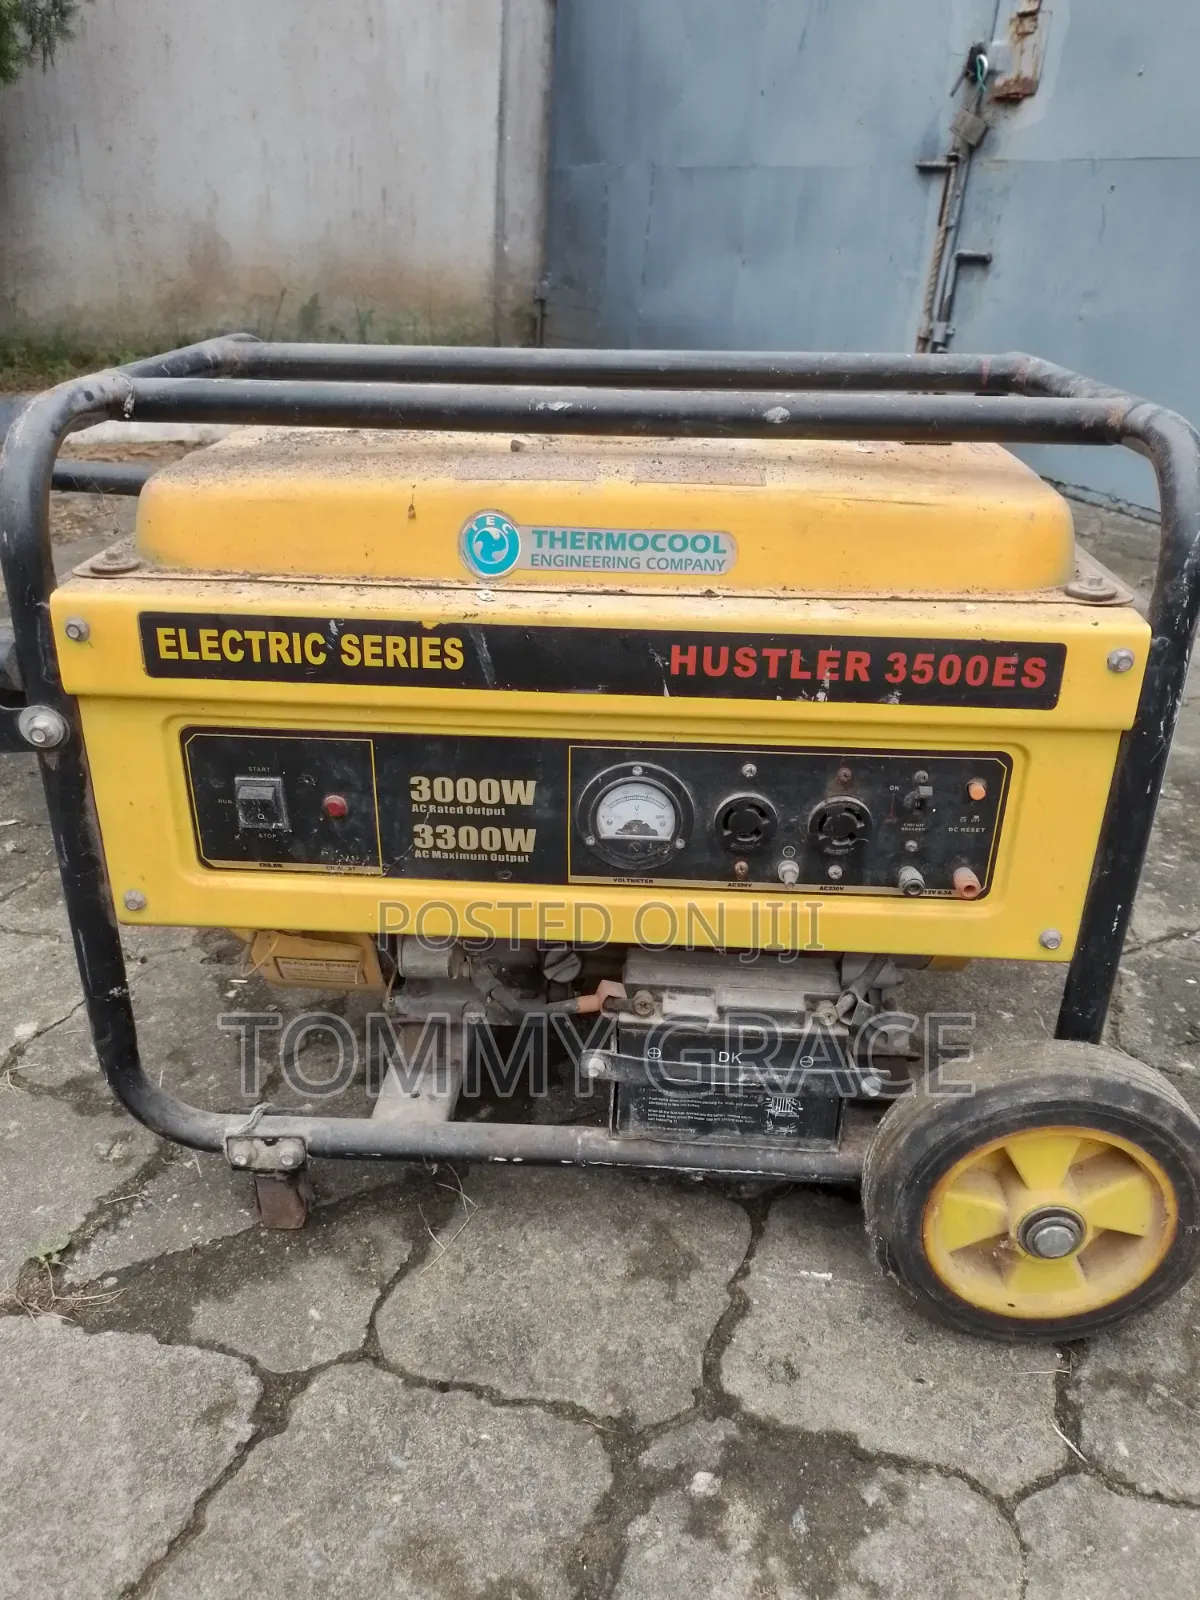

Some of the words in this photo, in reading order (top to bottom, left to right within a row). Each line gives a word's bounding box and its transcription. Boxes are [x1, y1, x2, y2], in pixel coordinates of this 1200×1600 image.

[532, 530, 727, 554] THERMOCOOL
[531, 553, 641, 570] ENGINEERING
[646, 556, 726, 572] COMPANY
[156, 627, 327, 666] ELECTRIC
[340, 634, 465, 671] SERIES
[670, 644, 872, 683] HUSTLER
[884, 652, 1048, 689] 3500ES
[409, 775, 537, 806] 3000W
[412, 804, 428, 813] AC
[429, 805, 463, 815] Rated
[466, 806, 506, 816] Output
[413, 823, 537, 853] 3300W
[414, 849, 430, 859] AC
[432, 851, 488, 861] Maximum
[490, 853, 530, 863] Output
[613, 877, 654, 885] VOLTMETER
[718, 1051, 742, 1064] DK
